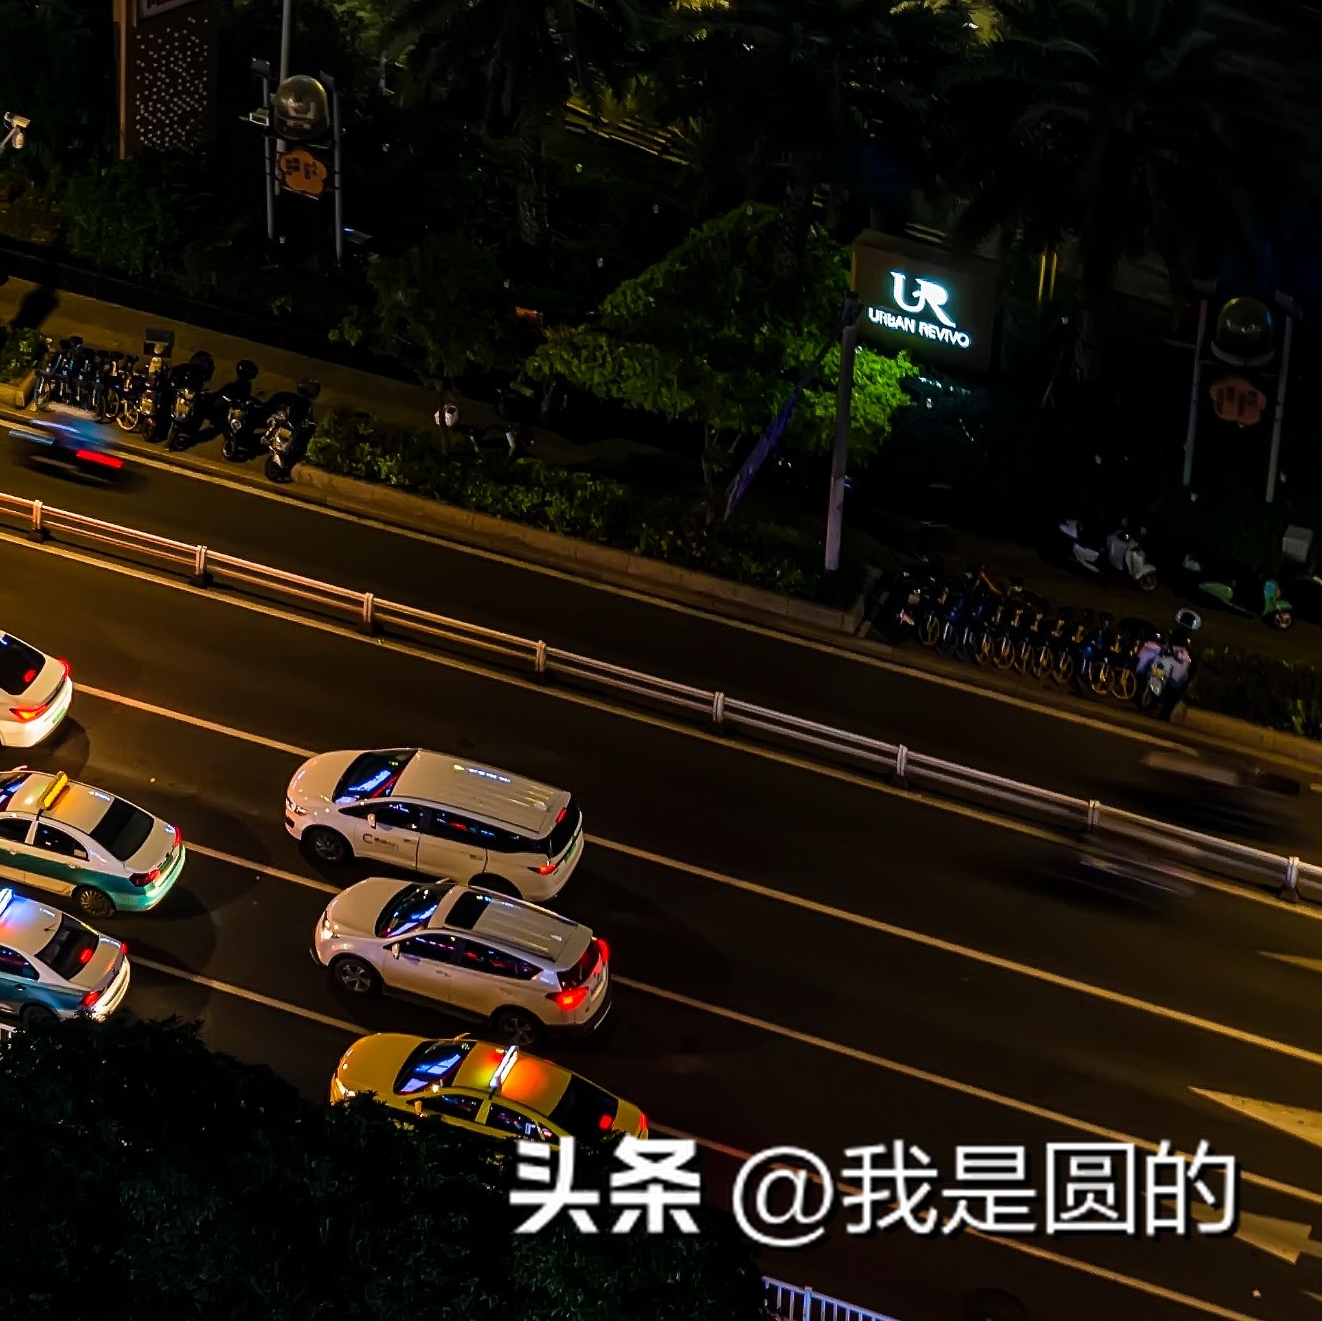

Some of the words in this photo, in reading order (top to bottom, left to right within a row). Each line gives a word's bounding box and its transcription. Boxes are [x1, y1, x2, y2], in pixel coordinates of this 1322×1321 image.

[890, 271, 957, 329] UR
[868, 307, 916, 334] URBAN
[918, 321, 970, 349] REVIVO
